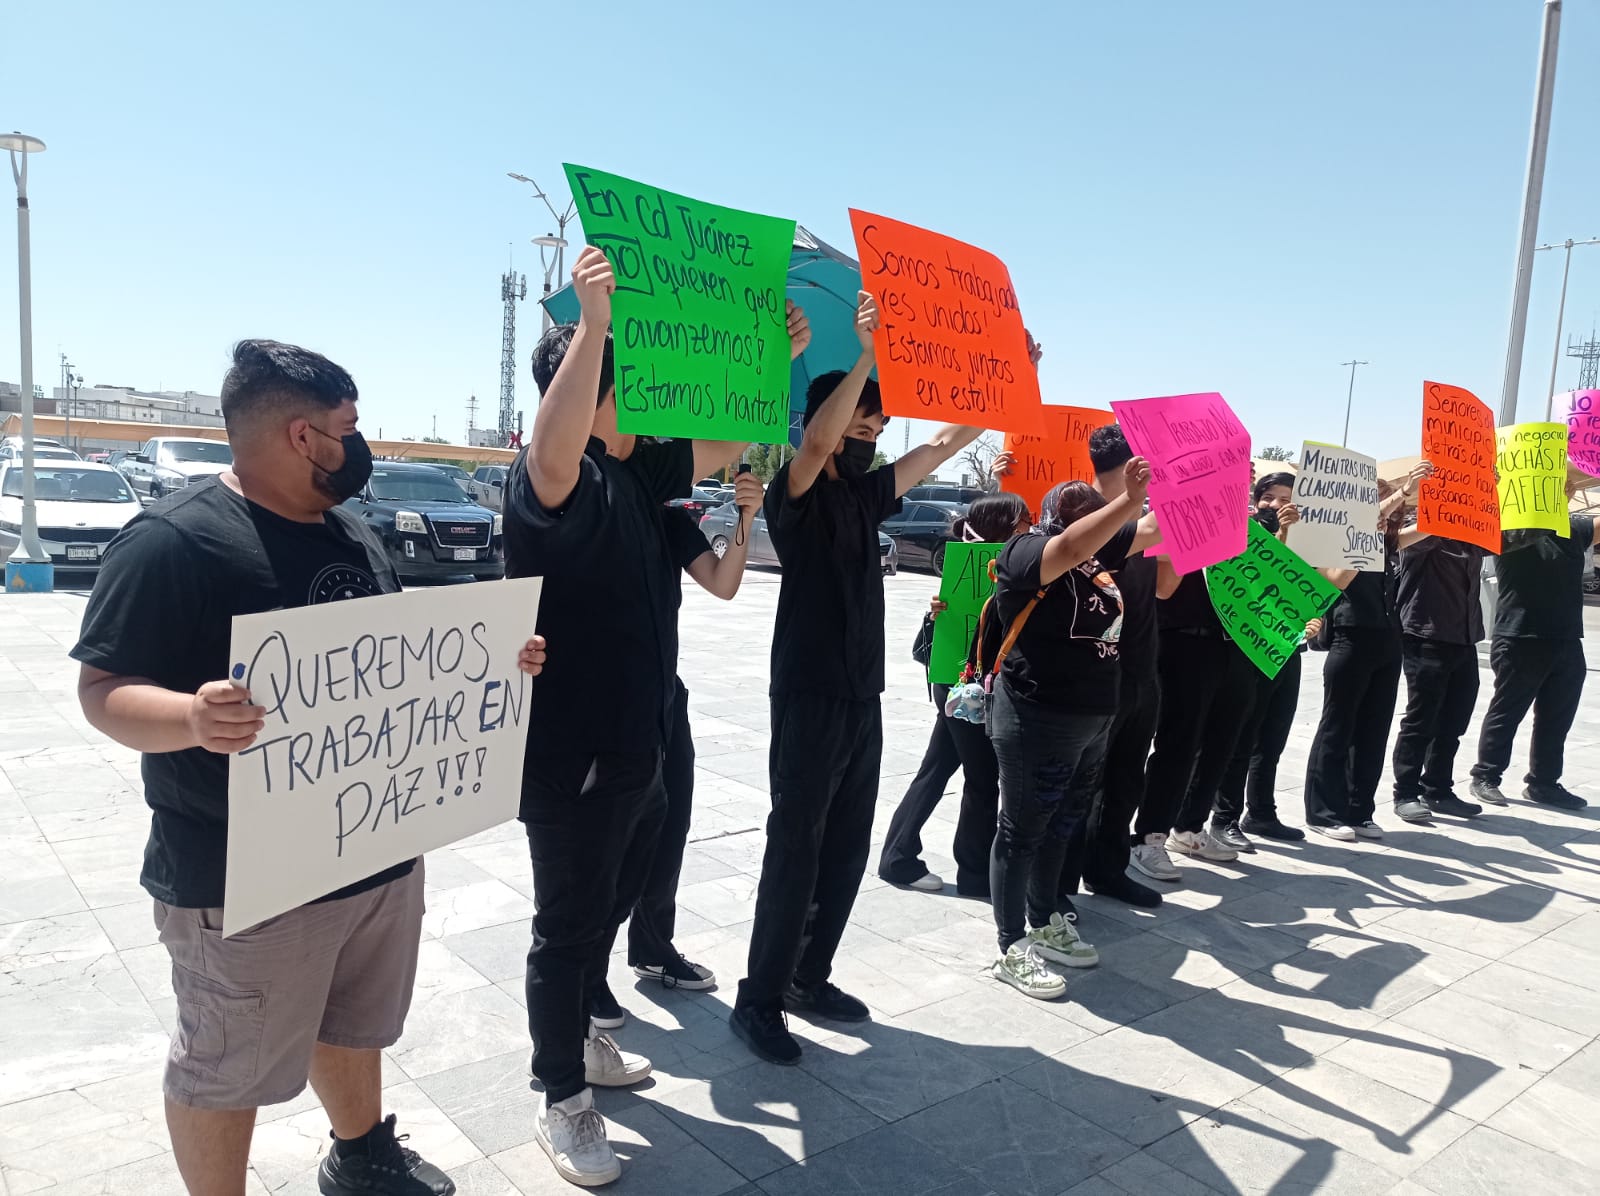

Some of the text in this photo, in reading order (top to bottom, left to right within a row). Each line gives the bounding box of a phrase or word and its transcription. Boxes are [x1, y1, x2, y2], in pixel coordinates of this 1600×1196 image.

[575, 173, 628, 222] En
[636, 193, 672, 240] Cd
[863, 225, 939, 289] Somos
[745, 287, 781, 337] que
[879, 290, 915, 322] res
[885, 323, 961, 372] Estamos
[620, 364, 714, 419] Estamos
[916, 378, 942, 406] en
[1429, 385, 1483, 426] Señores
[1120, 407, 1158, 455] MI
[1424, 437, 1467, 464] detrás
[1470, 449, 1488, 469] de
[1026, 455, 1056, 483] HAY
[1432, 466, 1494, 501] egocio hay
[1160, 493, 1220, 553] FORMA
[1220, 603, 1238, 620] de
[1222, 576, 1246, 599] no
[246, 621, 489, 724] QUEREMOS
[238, 670, 523, 793] TRABAJAR EN
[335, 746, 487, 857] PAZ!!!
